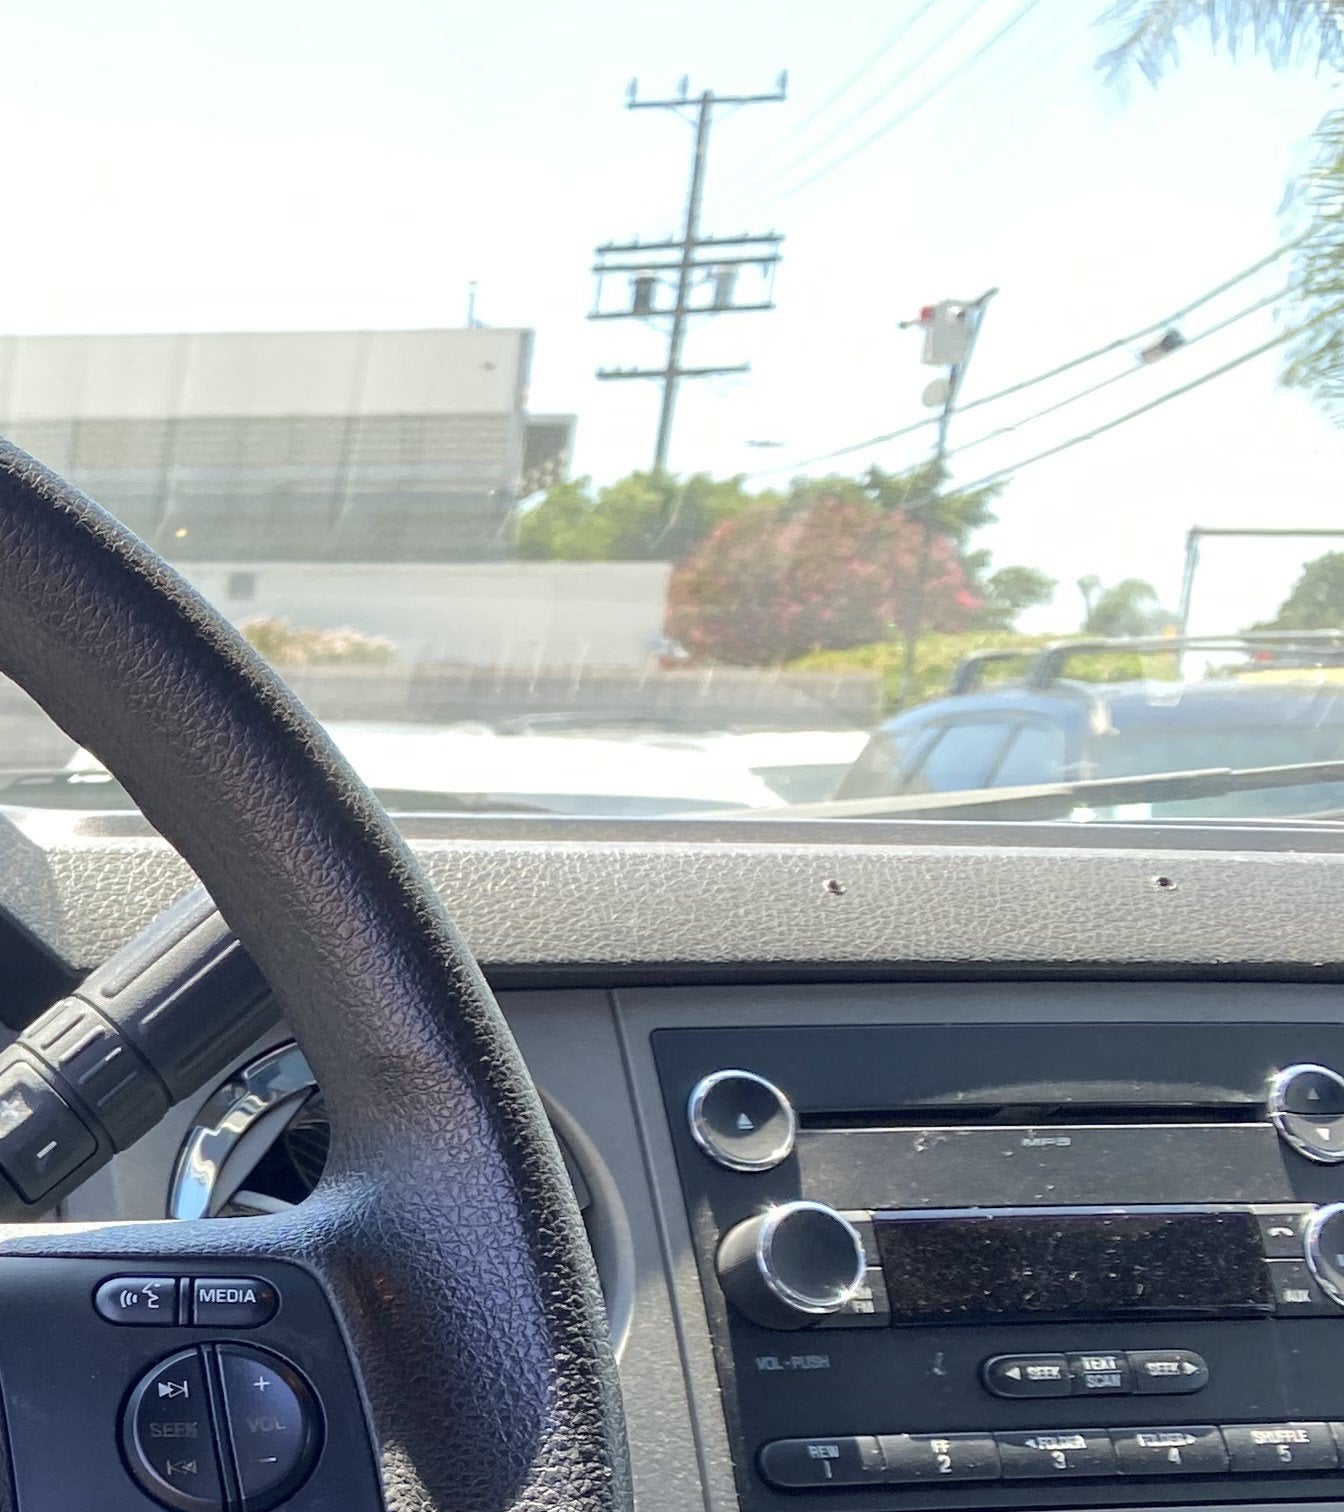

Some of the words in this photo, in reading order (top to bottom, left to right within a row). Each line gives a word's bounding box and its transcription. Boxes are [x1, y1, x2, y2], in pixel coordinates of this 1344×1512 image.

[198, 1288, 257, 1304] MEDIA
[1025, 1365, 1062, 1380] SEEK
[148, 1421, 199, 1439] SEEK
[246, 1416, 287, 1434] VOL
[1250, 1428, 1311, 1445] SHUFFLE
[1051, 1450, 1067, 1470] 3
[1276, 1444, 1292, 1463] 5
[936, 1454, 953, 1474] 2
